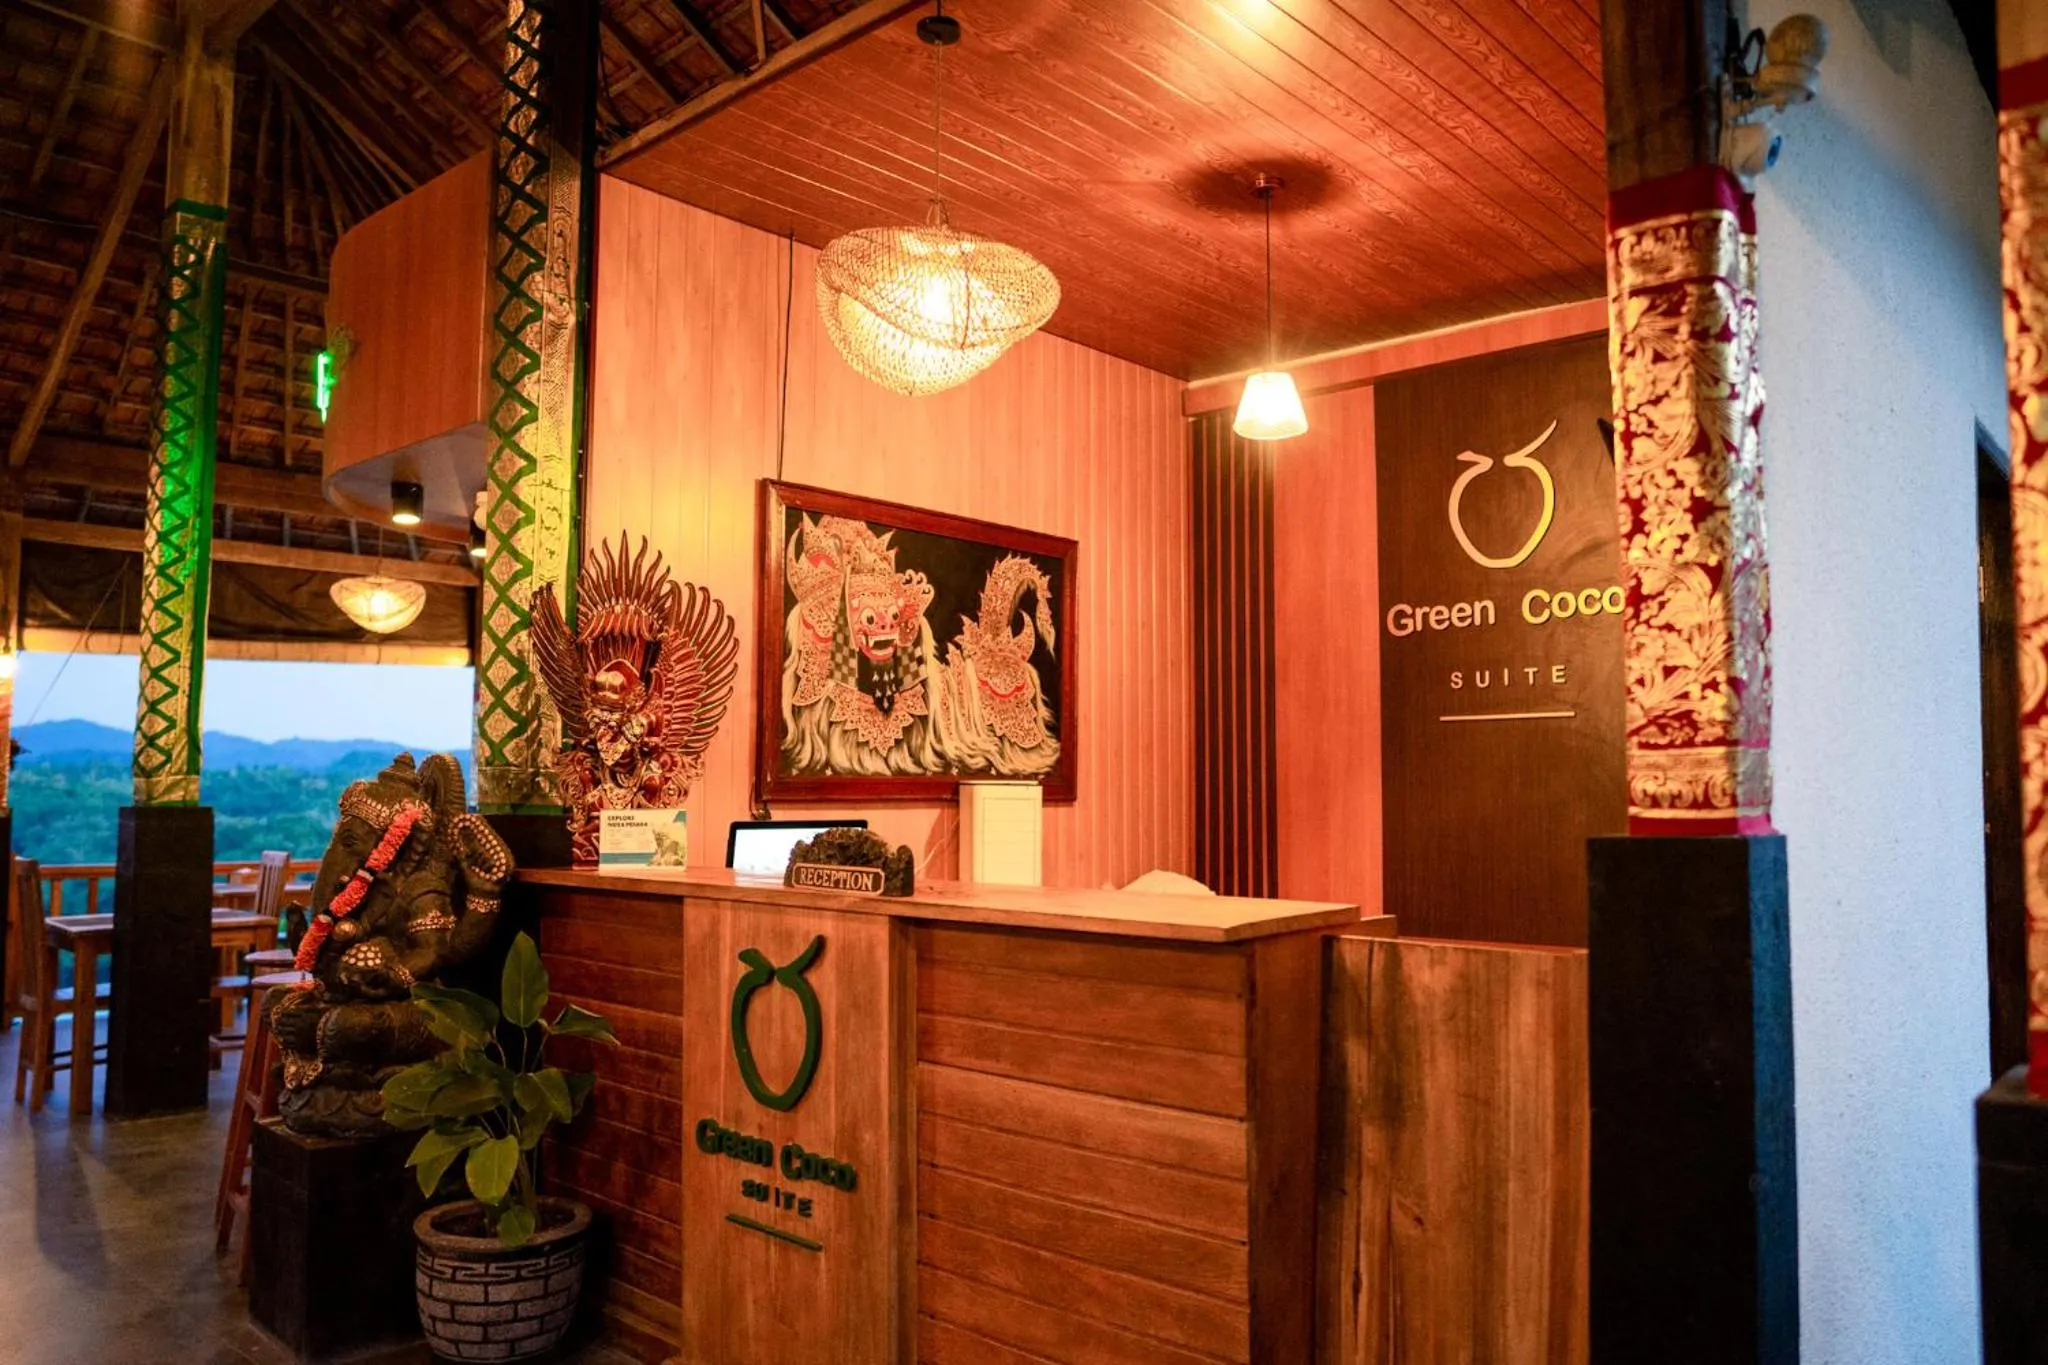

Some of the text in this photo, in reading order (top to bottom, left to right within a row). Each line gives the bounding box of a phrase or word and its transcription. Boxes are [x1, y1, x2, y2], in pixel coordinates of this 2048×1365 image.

[1387, 586, 1626, 636] Green Coco
[1450, 664, 1567, 689] SUITE
[800, 867, 874, 891] RECEPTION
[696, 1118, 857, 1191] Green Coco
[741, 1179, 813, 1217] SUITE
